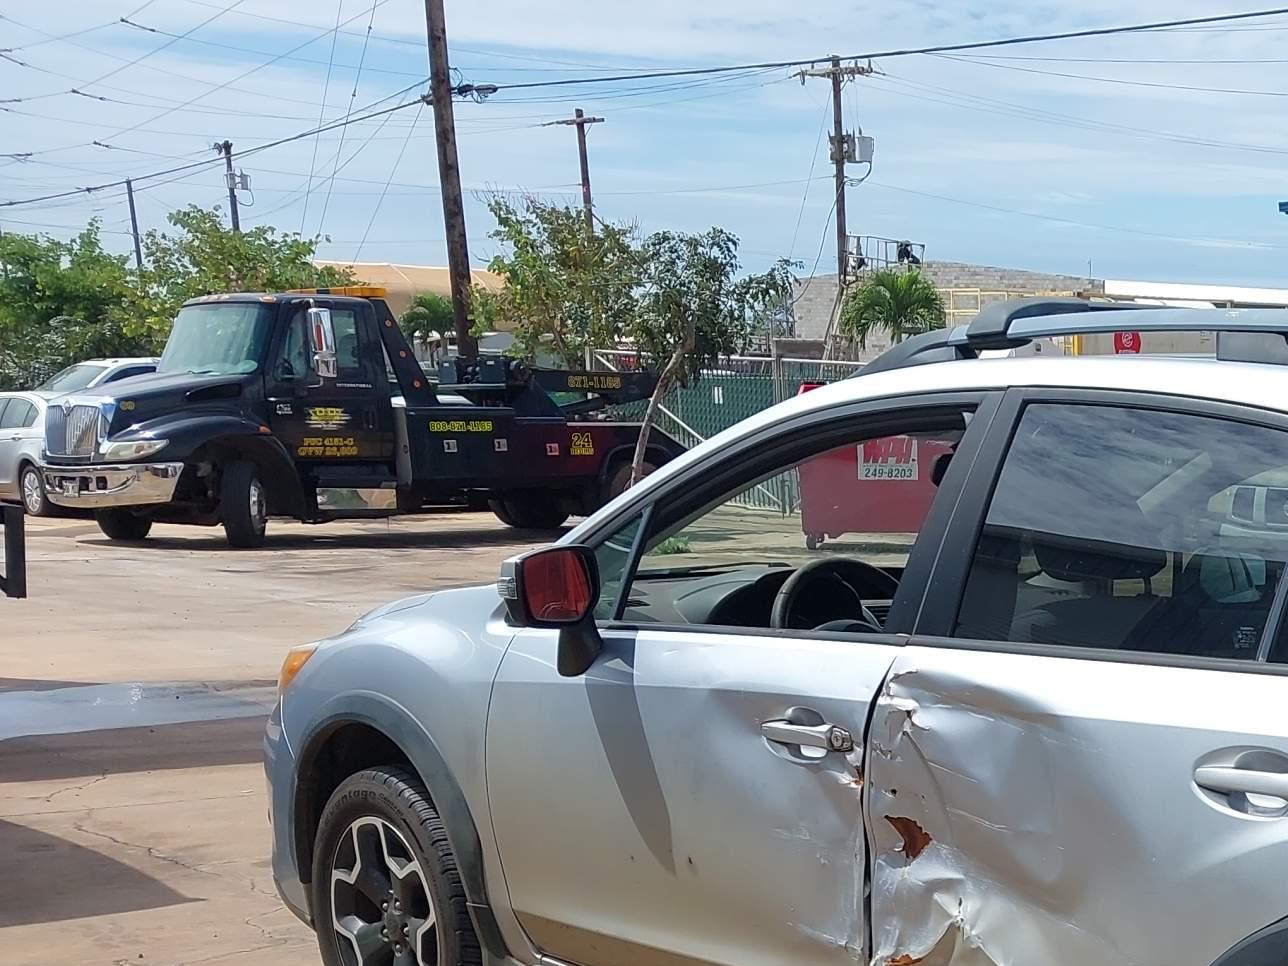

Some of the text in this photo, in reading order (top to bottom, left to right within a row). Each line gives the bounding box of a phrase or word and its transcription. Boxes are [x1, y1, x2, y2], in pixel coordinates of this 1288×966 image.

[568, 375, 621, 390] 871-1185
[429, 420, 492, 433] 808-871-1185
[571, 432, 592, 448] 24
[865, 467, 913, 478] 249-8203
